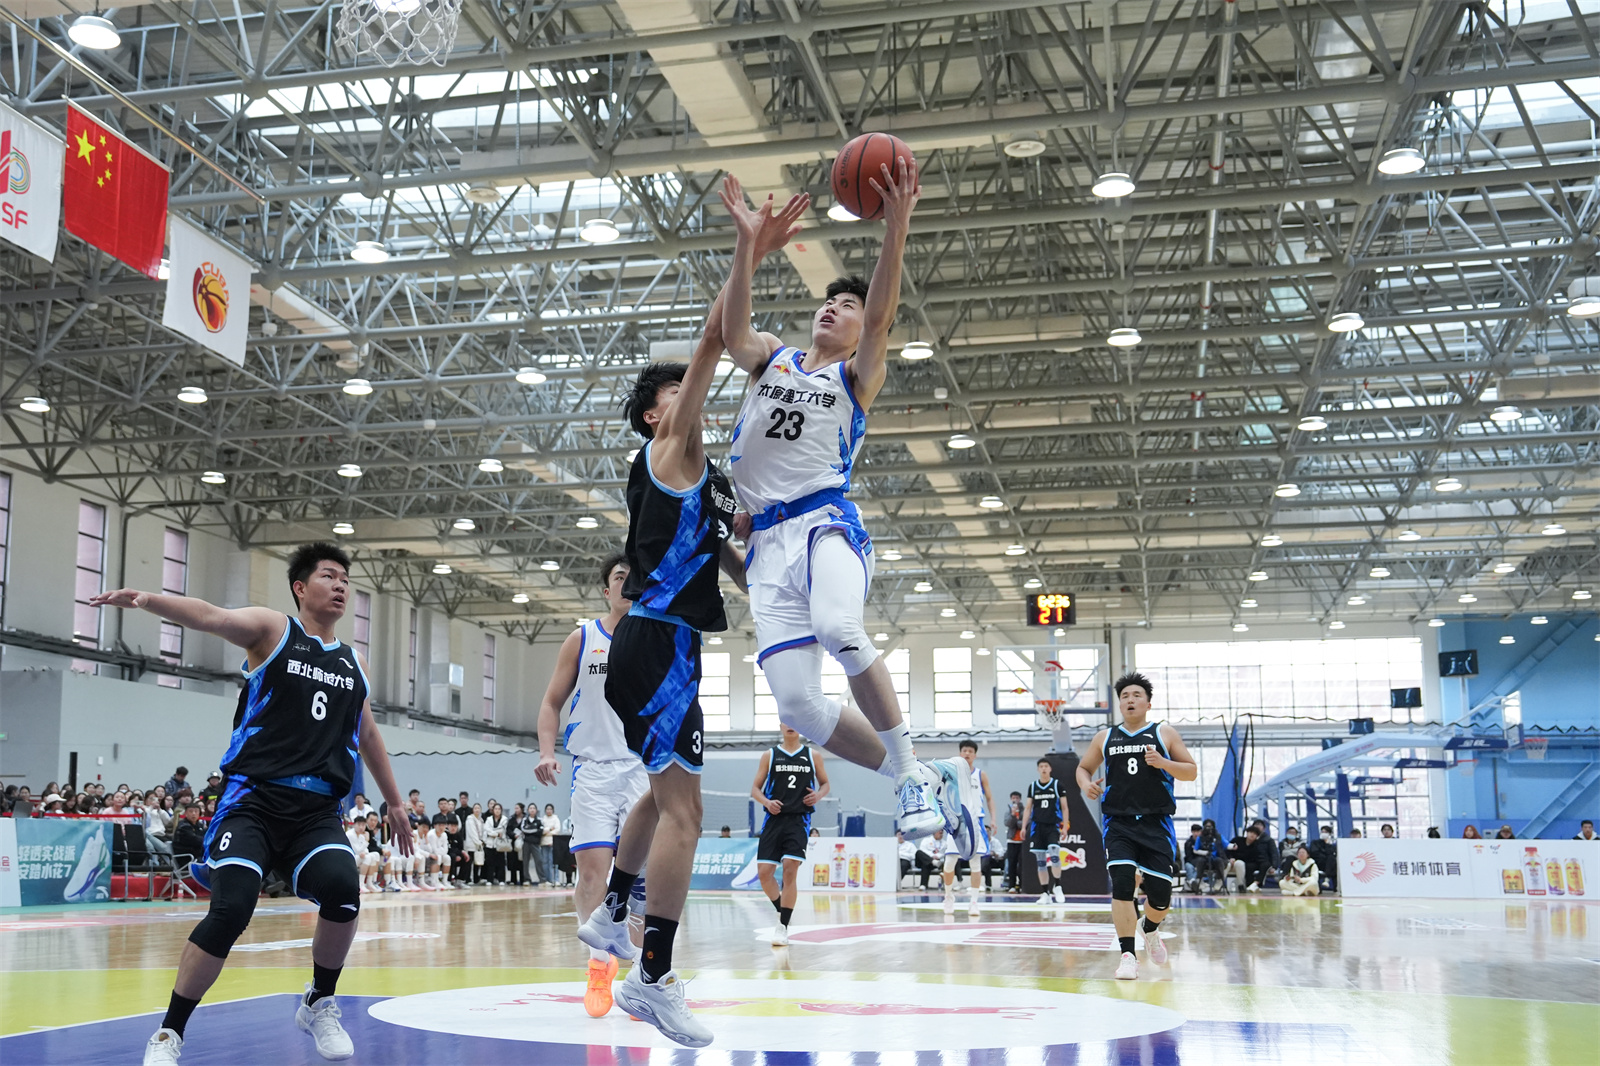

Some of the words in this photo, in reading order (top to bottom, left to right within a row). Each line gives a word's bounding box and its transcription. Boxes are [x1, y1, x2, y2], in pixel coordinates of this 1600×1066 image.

[757, 383, 836, 408] 太原理工大学
[765, 407, 805, 441] 23
[287, 659, 354, 691] 西北师范大学
[311, 690, 328, 720] 6
[692, 731, 702, 754] 3
[1127, 757, 1138, 775] 8
[787, 774, 797, 789] 2
[219, 831, 233, 852] 6
[1393, 861, 1462, 876] 橙狮体育
